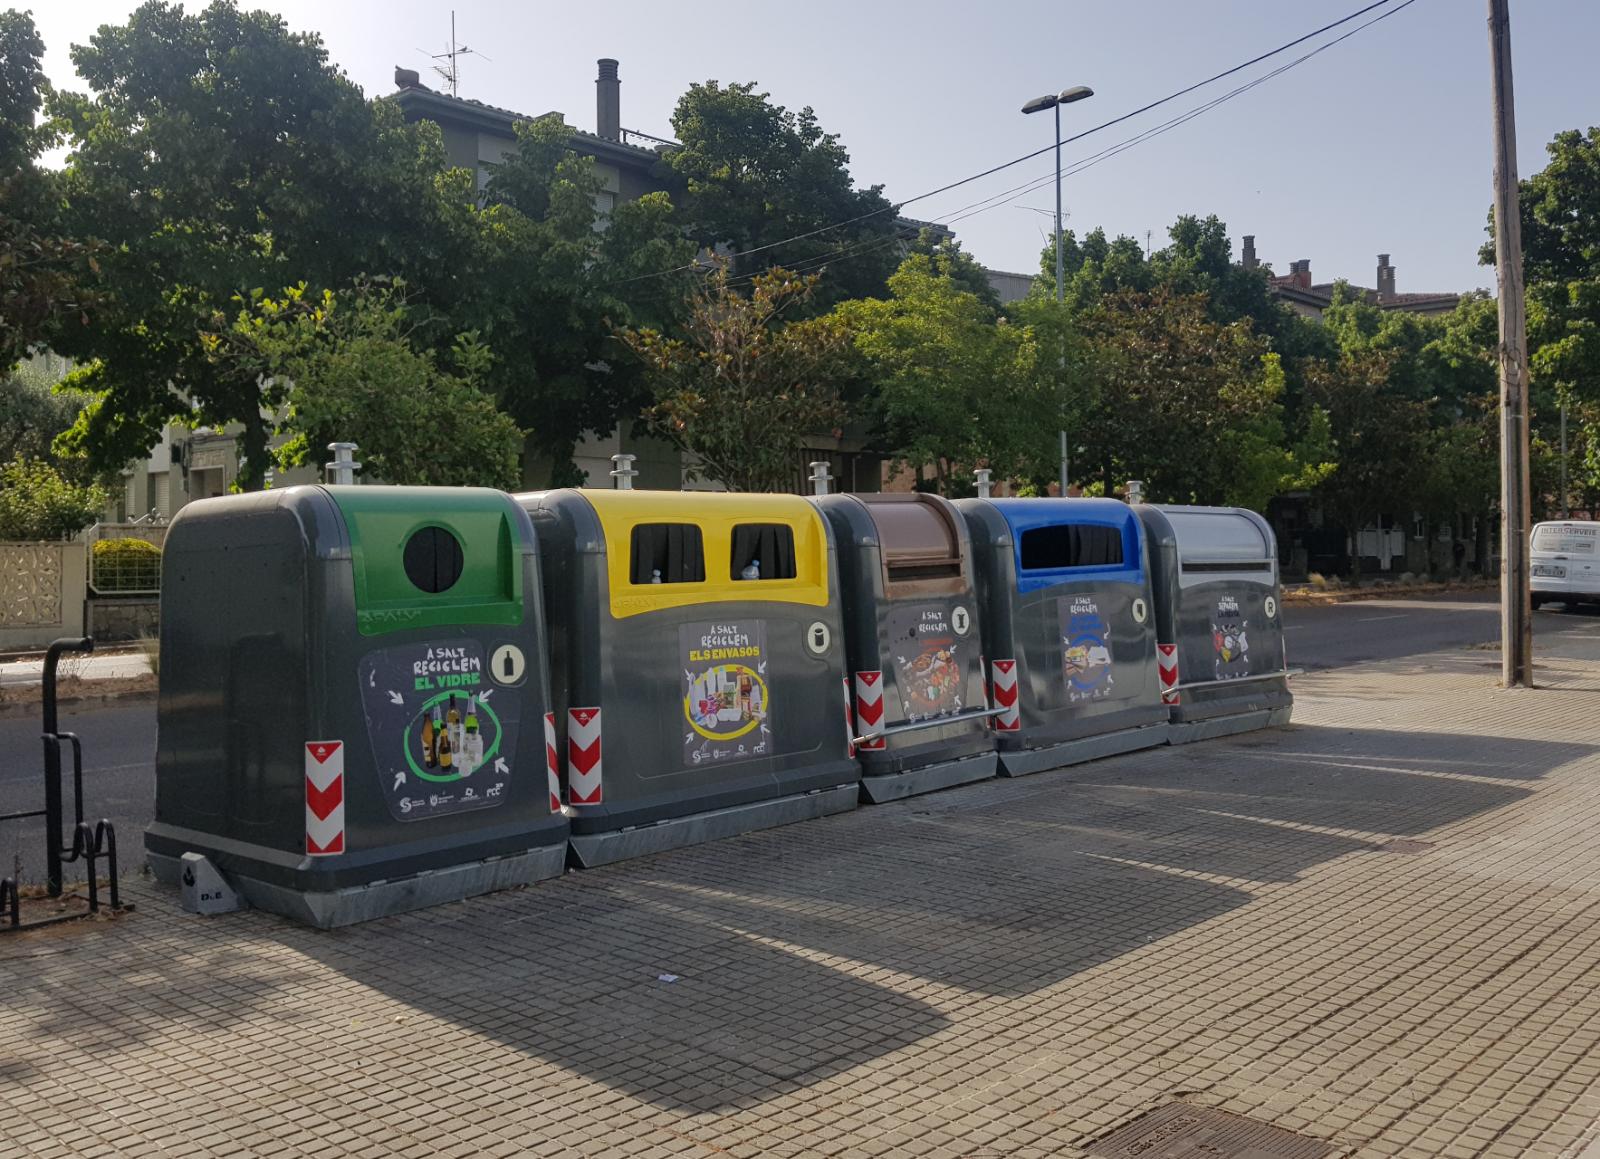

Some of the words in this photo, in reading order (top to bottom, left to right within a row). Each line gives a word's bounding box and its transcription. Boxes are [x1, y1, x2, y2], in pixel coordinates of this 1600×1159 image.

[1267, 602, 1274, 613] R
[926, 611, 943, 621] SALT
[710, 625, 716, 635] A
[717, 625, 738, 635] SALT
[918, 623, 948, 633] RECICLEM
[701, 634, 749, 649] RECICLEM
[427, 648, 434, 659] A
[435, 647, 465, 658] SALT
[689, 649, 711, 662] ELS
[711, 646, 760, 660] ENVASOS
[413, 656, 481, 676] RECICLEM
[414, 676, 434, 690] EL
[436, 671, 481, 688] VIDRE
